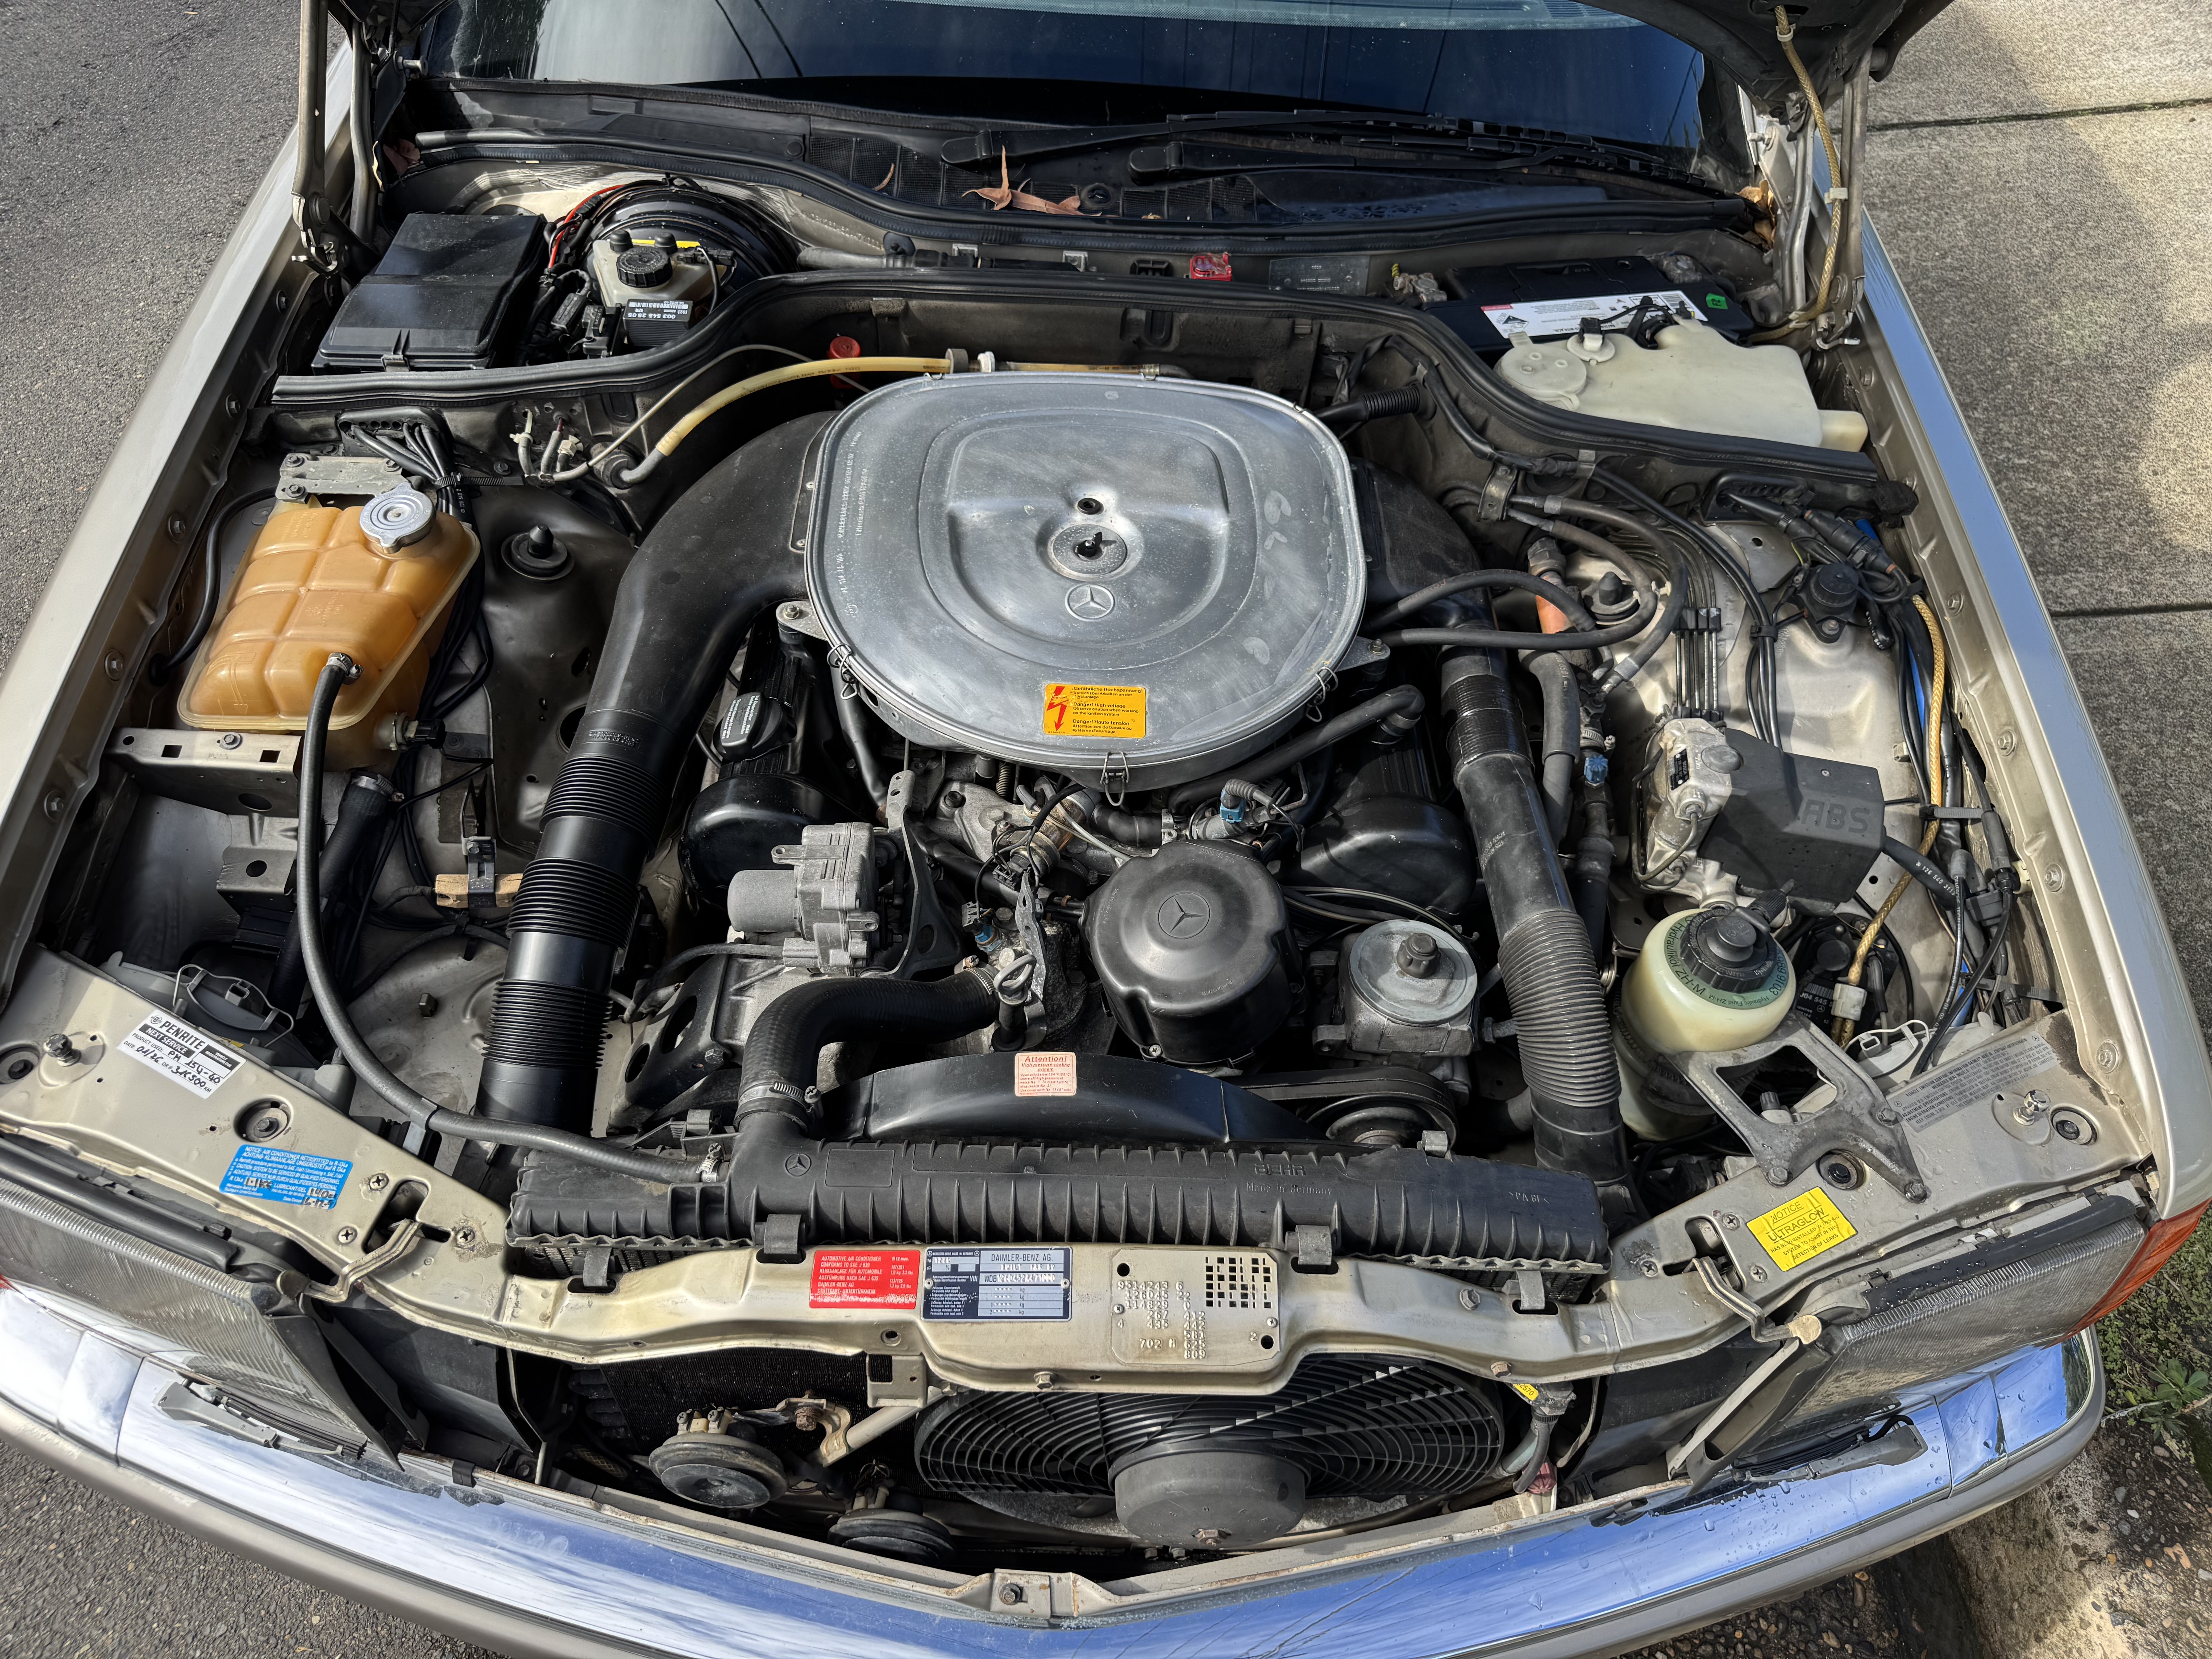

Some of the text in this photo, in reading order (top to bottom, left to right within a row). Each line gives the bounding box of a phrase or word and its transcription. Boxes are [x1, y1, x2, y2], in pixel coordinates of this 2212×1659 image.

[1800, 799, 1870, 834] ABS
[1922, 866, 1944, 884] 126 540
[1675, 968, 1705, 996] ZH-M
[1814, 996, 1827, 1005] 545
[145, 1027, 189, 1054] NEXT SERVICE
[158, 1020, 206, 1050] PENRITE
[131, 1032, 165, 1053] PRODUCT USED:
[263, 1154, 297, 1164] KLIMAANLAGE
[270, 1150, 301, 1159] CONDITIONER
[299, 1155, 329, 1164] RETROFITTED
[1254, 1161, 1308, 1179] BEHR
[1246, 1182, 1332, 1197] Made in Germany
[1768, 1200, 1803, 1223] NOTICE
[1767, 1207, 1827, 1242] ULTRAGLOW
[1769, 1245, 1781, 1253] HAS
[1791, 1226, 1817, 1242] INSTALLED
[1782, 1243, 1802, 1256] SYSTEM
[1791, 1244, 1817, 1260] DETECTION
[1822, 1233, 1839, 1243] LEAKS
[1118, 1280, 1183, 1291] 9514243 6
[1125, 1290, 1190, 1301] 126045 22
[1125, 1300, 1190, 1310] 114829 0
[1147, 1310, 1206, 1321] 267 412
[1118, 1319, 1206, 1330] 4 435 442
[1184, 1330, 1206, 1340] 581
[1250, 1332, 1257, 1342] 2
[1140, 1338, 1206, 1349] 702 625
[1184, 1349, 1206, 1359] 809
[1517, 1383, 1535, 1396] 2570
